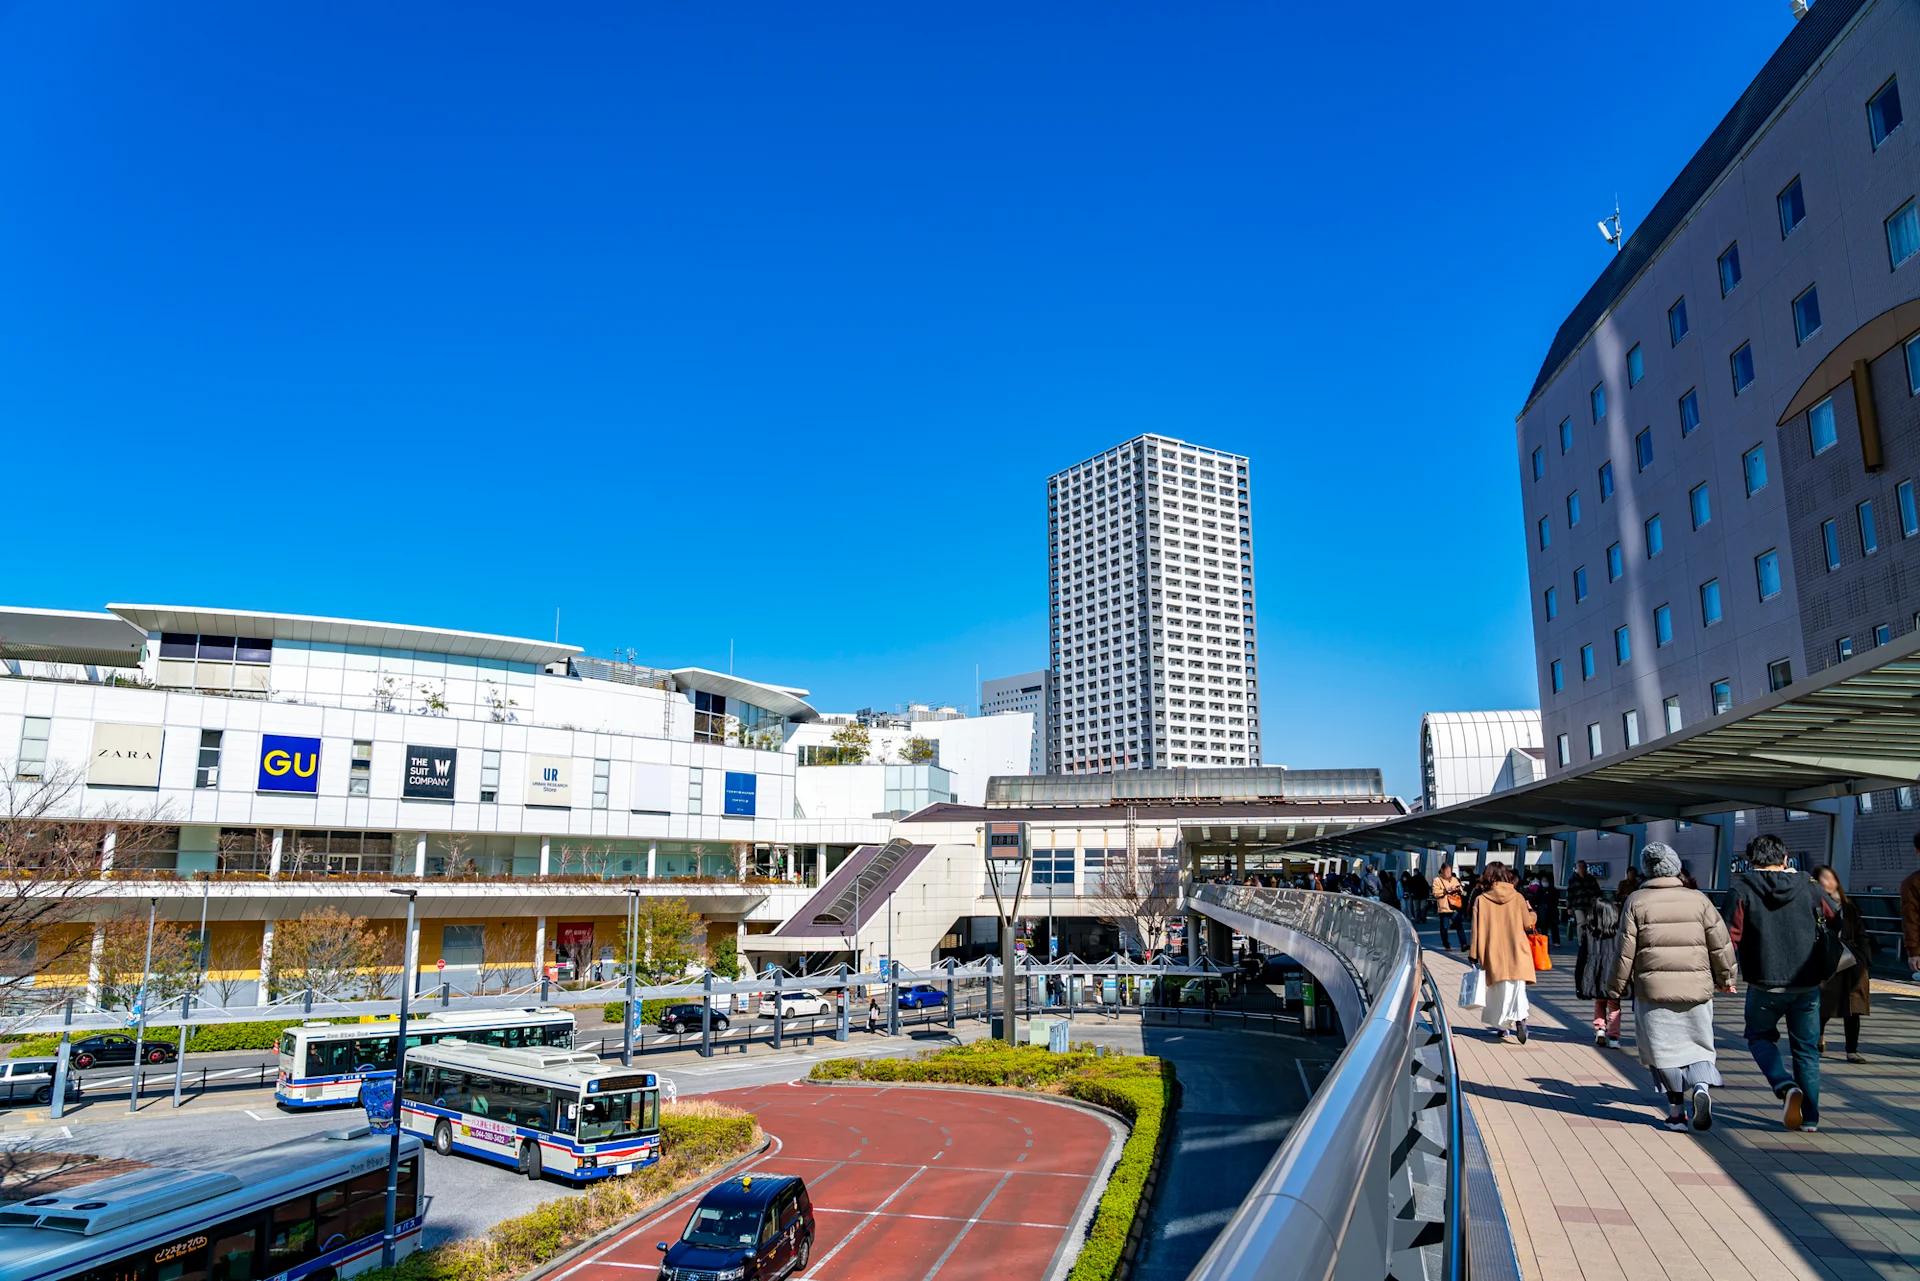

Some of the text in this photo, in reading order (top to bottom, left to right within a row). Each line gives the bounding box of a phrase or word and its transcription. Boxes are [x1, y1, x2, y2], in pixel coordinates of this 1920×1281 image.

[98, 749, 153, 759] ZARA
[263, 749, 317, 778] GU
[411, 757, 428, 767] THE
[410, 767, 429, 776] SUIT
[543, 767, 559, 781] UR
[409, 776, 450, 786] COMPANY
